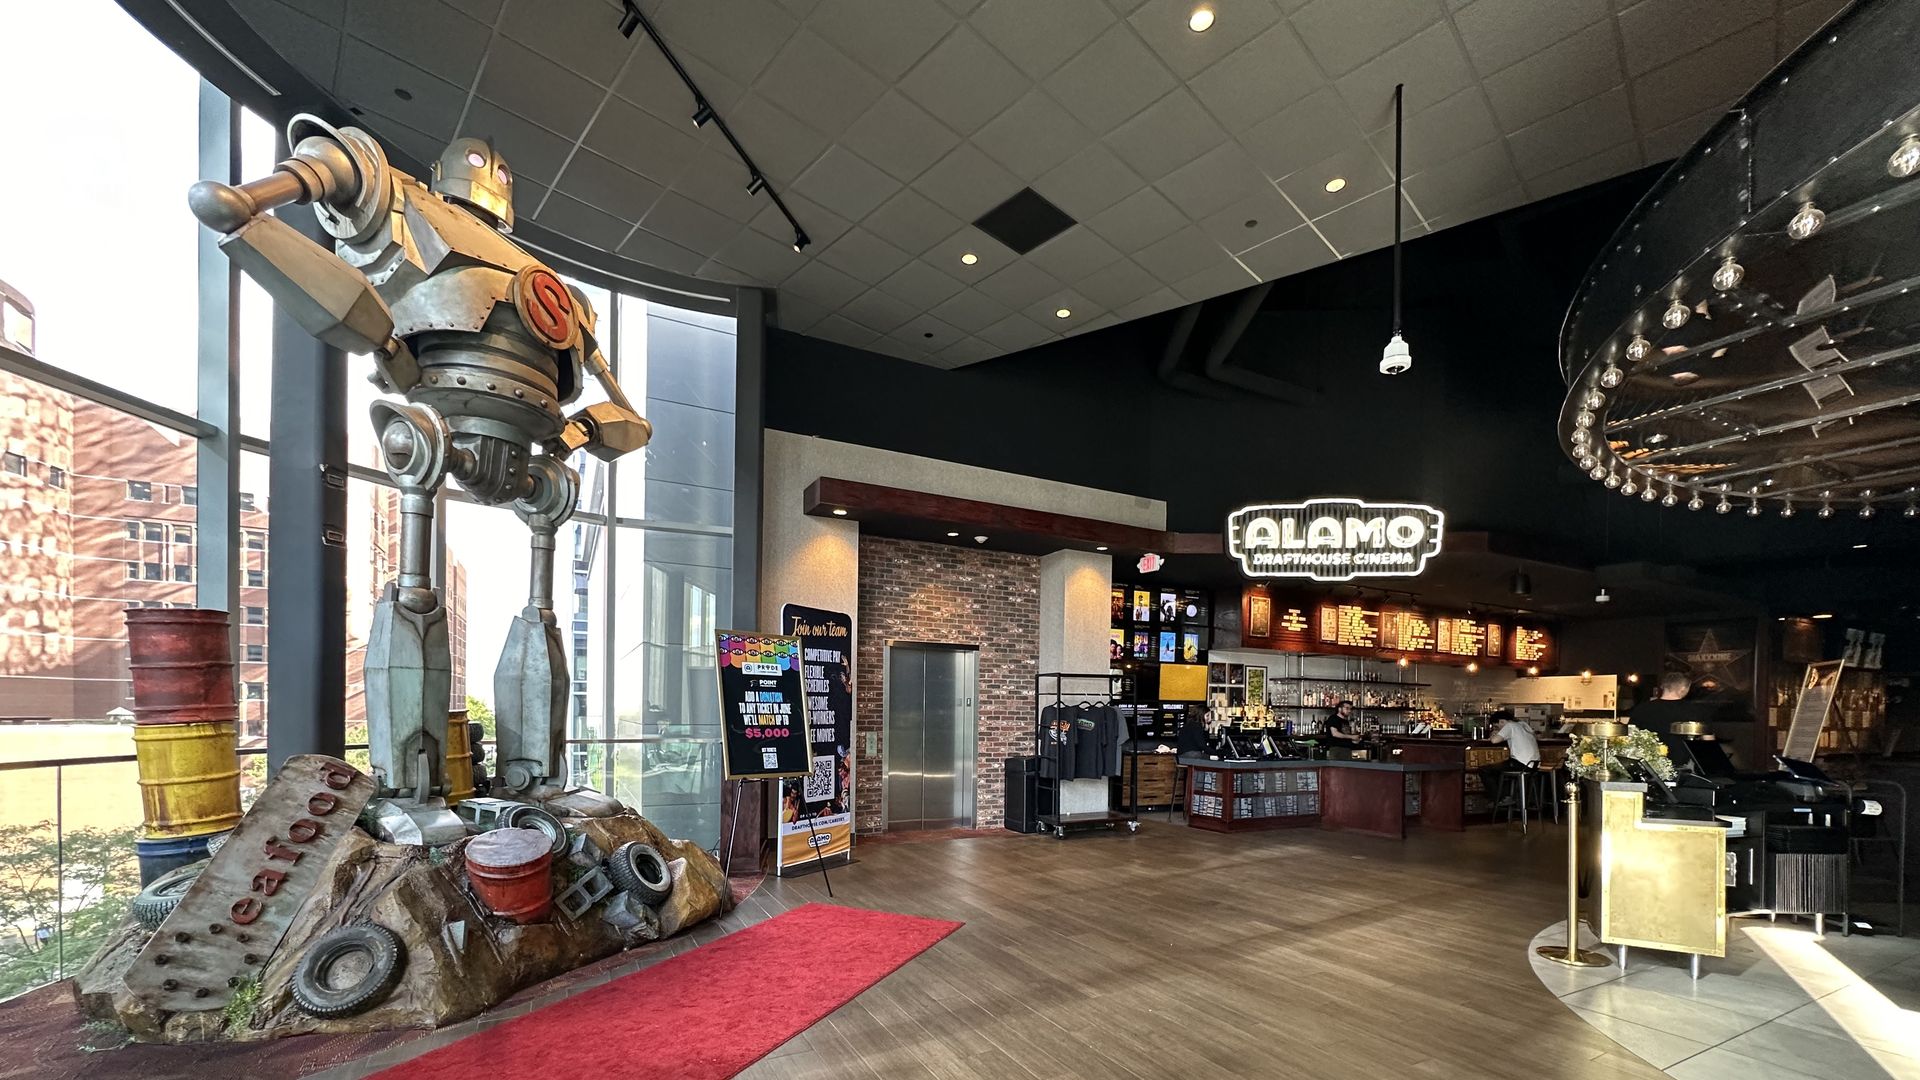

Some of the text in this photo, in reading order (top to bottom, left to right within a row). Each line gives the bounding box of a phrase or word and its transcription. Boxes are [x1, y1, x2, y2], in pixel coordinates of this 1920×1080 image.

[527, 271, 571, 342] S
[1245, 515, 1425, 549] ALAMO
[1253, 552, 1414, 566] DRAFTHOUSE CINEMA
[792, 616, 848, 637] Join our team
[804, 648, 841, 664] COMPETITIVE PAY
[804, 665, 825, 679] FLEXIBLE
[805, 679, 830, 693] SCHEDULES
[745, 691, 783, 703] ADD A DONATION
[808, 696, 829, 711] WESOME
[738, 702, 792, 714] TO ANY TICKET IN JUNE
[743, 714, 789, 726] WE'LL MATCH UP TO
[745, 727, 790, 739] $5,000
[817, 728, 835, 743] MOVIES
[791, 817, 845, 831] DRAFTHOSE.COM/CAREERS
[230, 762, 356, 925] eafood
[809, 834, 830, 844] AAMO
